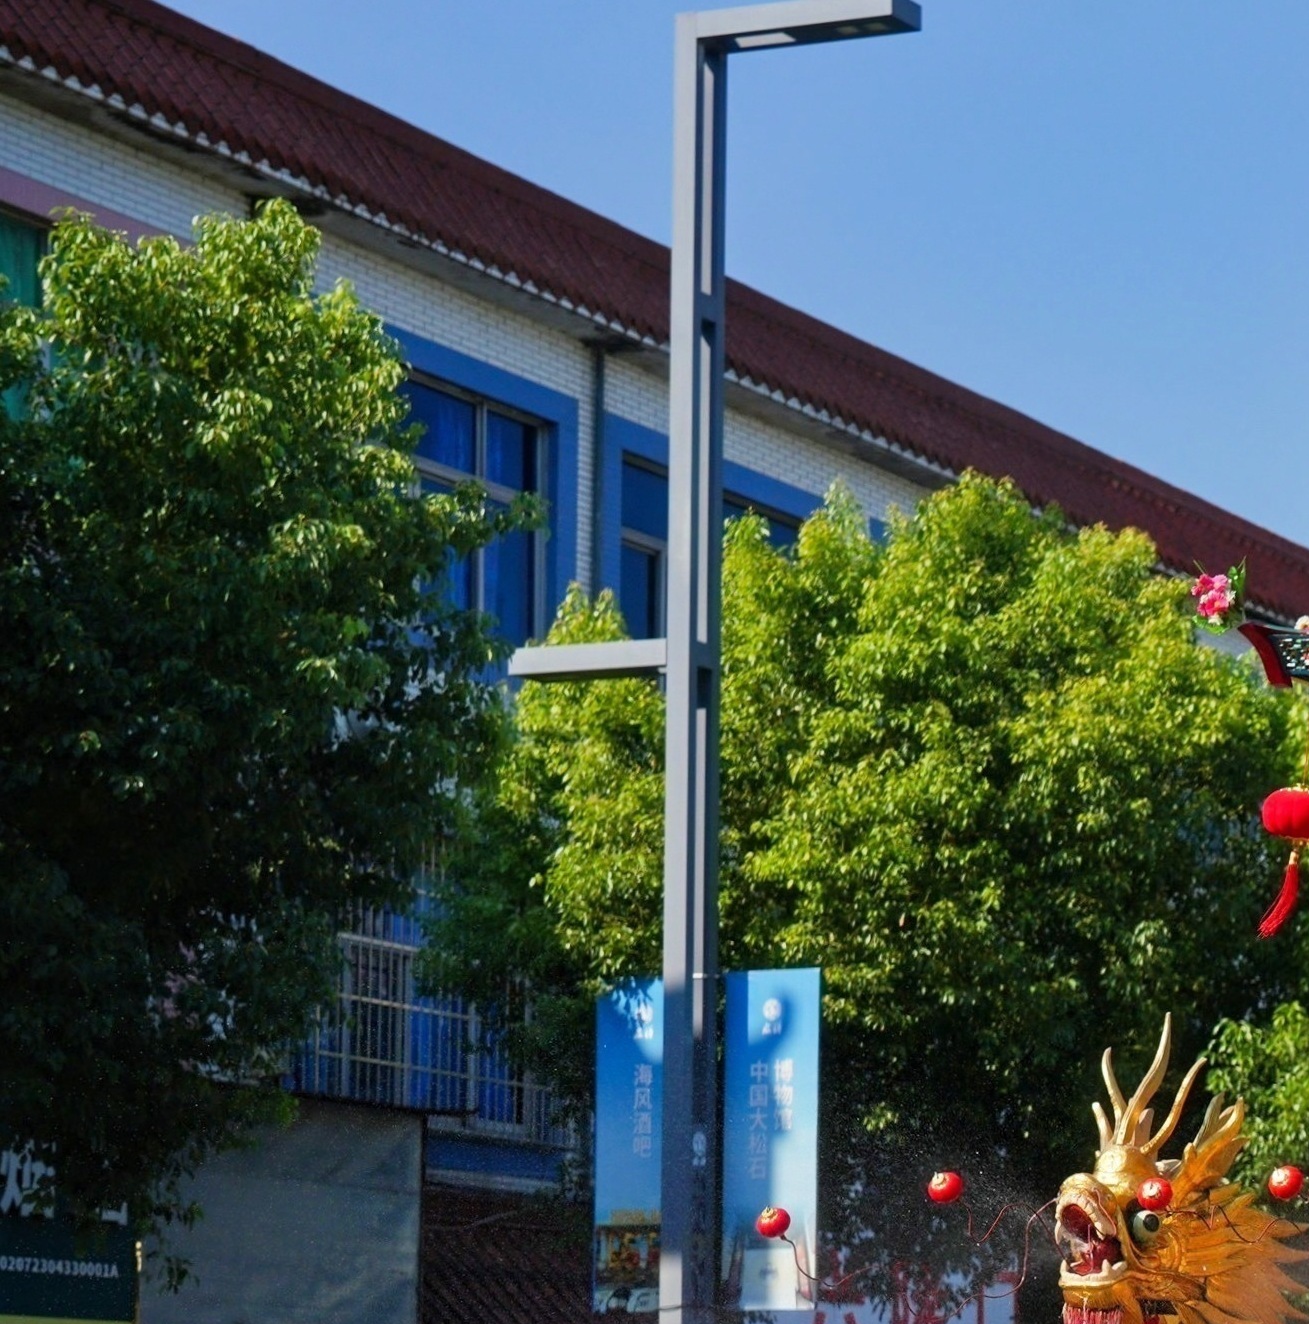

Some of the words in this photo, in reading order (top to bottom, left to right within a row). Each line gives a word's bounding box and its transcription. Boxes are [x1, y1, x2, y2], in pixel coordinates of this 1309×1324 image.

[632, 1062, 654, 1158] 海风酒吧
[749, 1060, 769, 1180] 中国大松石
[773, 1058, 795, 1132] 博物馆
